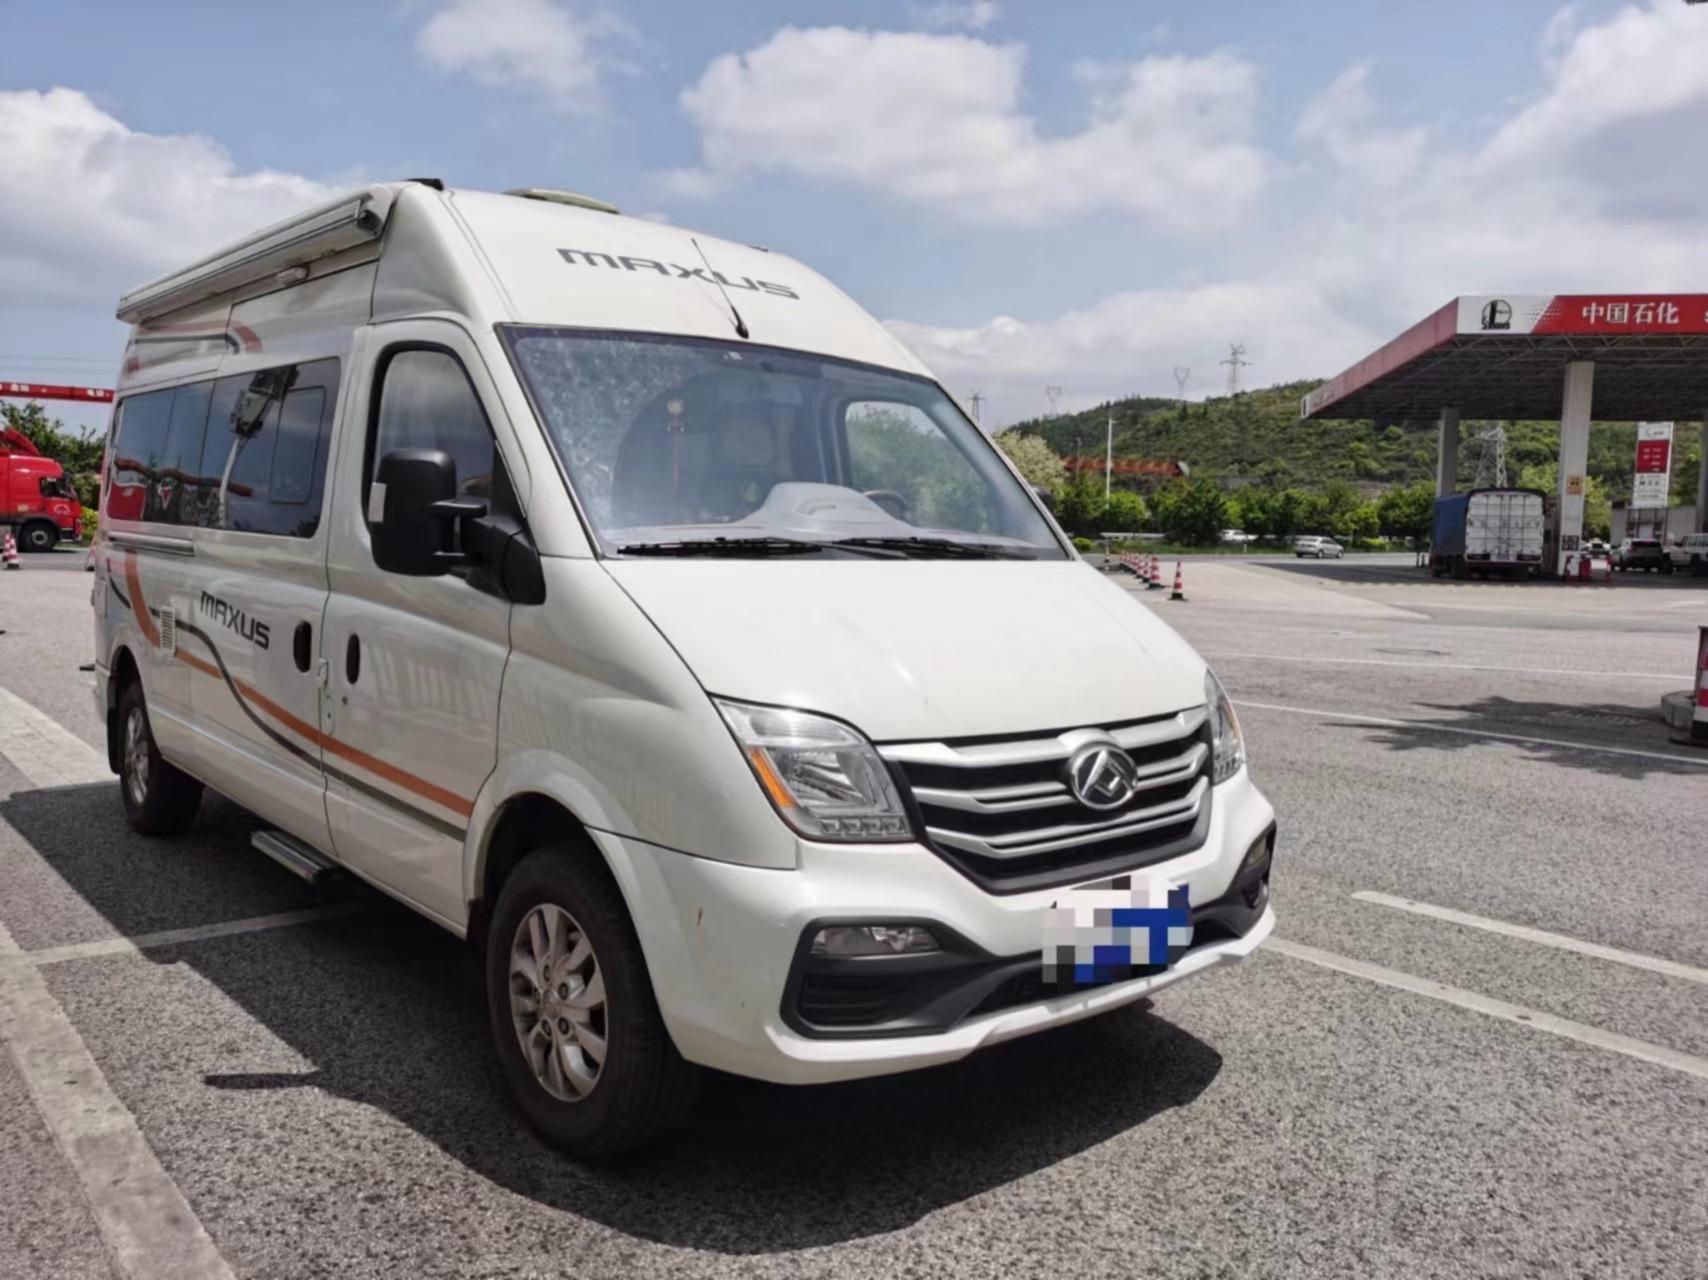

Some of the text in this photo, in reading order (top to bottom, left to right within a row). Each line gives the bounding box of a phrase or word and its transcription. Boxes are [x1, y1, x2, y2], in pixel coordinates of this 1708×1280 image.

[556, 248, 800, 300] MAXUS
[1582, 302, 1679, 325] 中国石化
[200, 590, 271, 651] MAXUS
